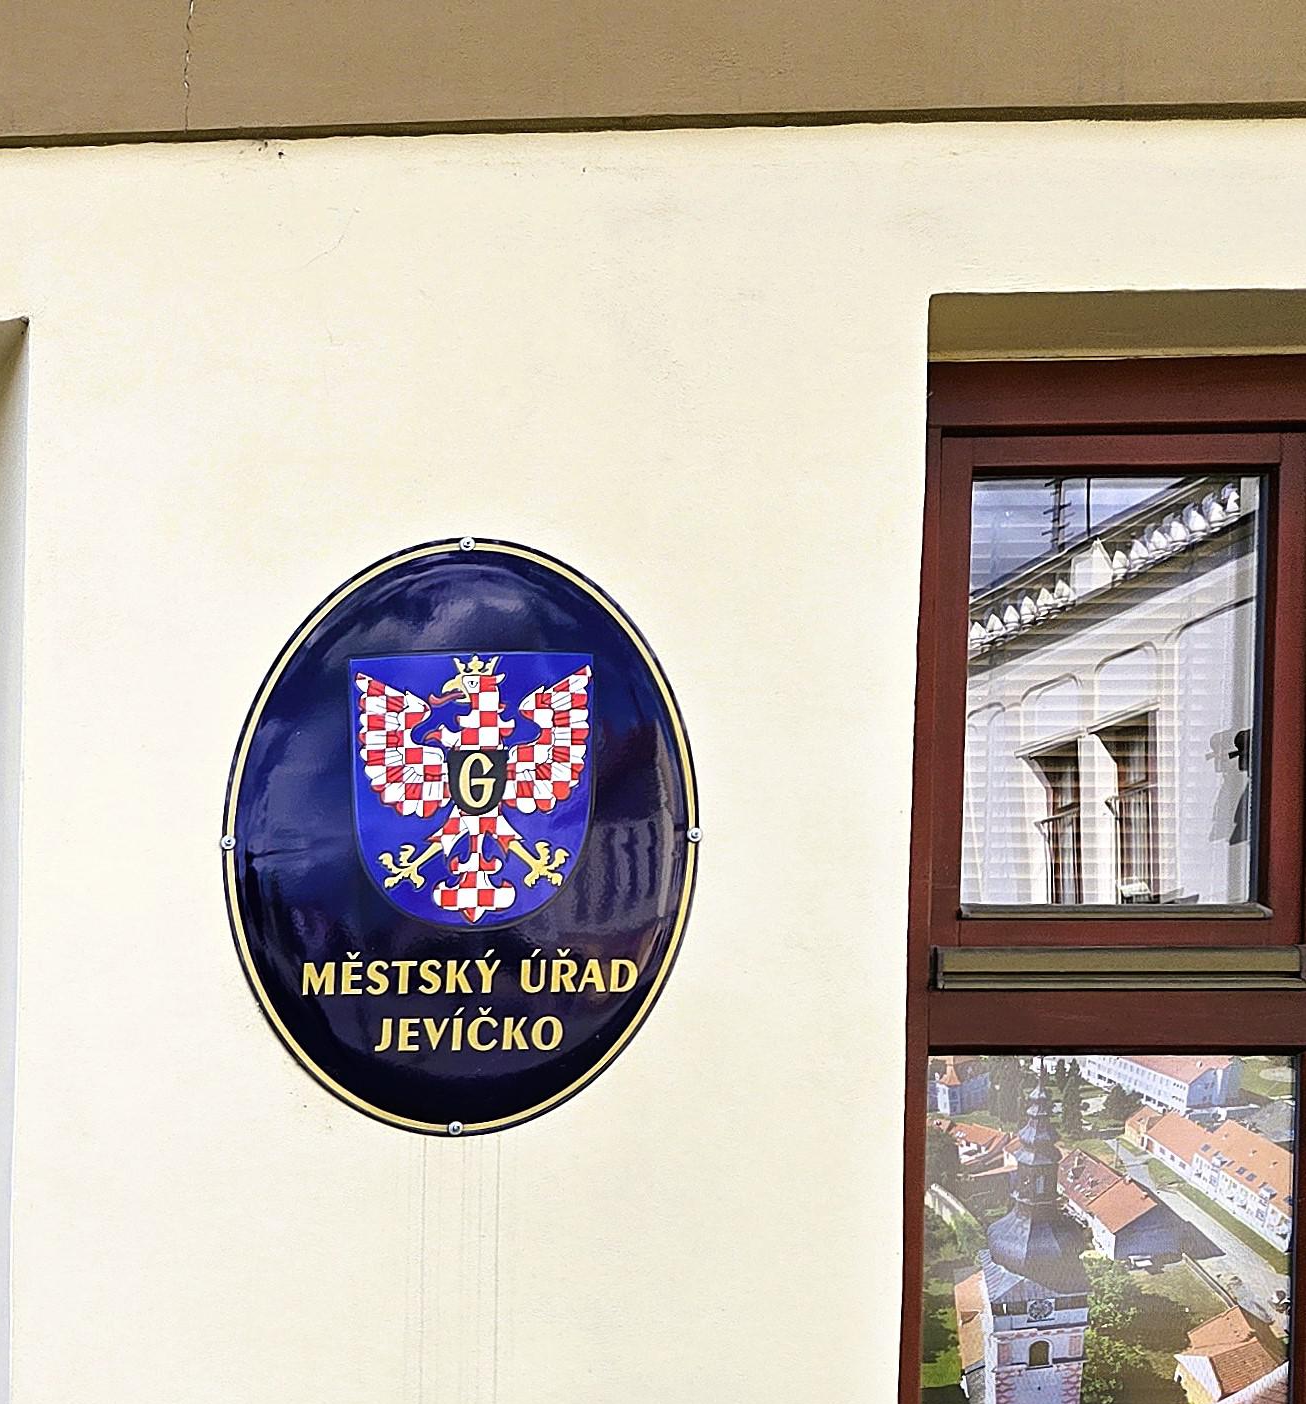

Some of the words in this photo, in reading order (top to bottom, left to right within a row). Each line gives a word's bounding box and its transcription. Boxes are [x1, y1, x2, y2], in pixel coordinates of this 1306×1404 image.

[458, 751, 495, 809] G
[301, 950, 502, 996] MĚSTSKÝ
[519, 949, 639, 994] ÚŘAD
[374, 1008, 564, 1052] JEVÍČKO
